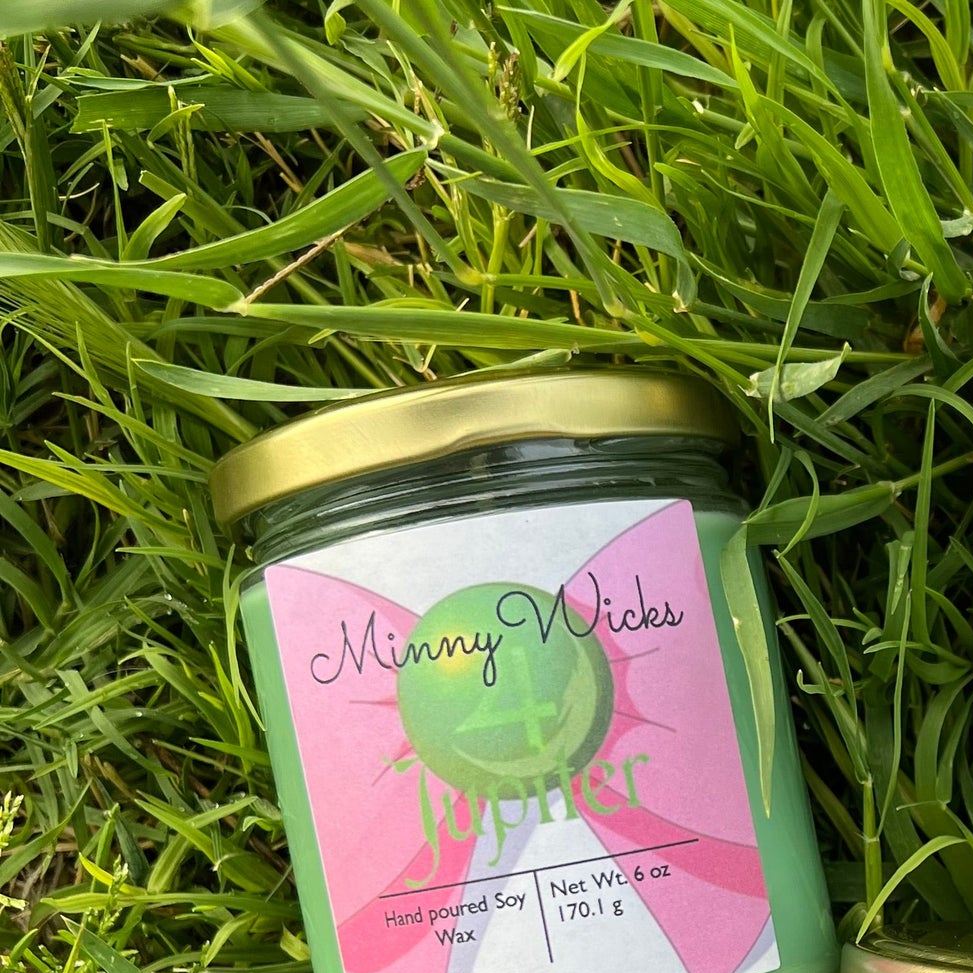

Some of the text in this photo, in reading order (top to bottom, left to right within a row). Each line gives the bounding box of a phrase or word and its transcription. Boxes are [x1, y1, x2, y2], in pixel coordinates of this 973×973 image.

[310, 572, 685, 688] Minny Wicks
[382, 751, 651, 889] Jupiter
[549, 864, 671, 899] Net Wt. 6 oz
[384, 891, 527, 930] Hand poured Soy
[557, 898, 625, 922] 170.1 g
[434, 925, 477, 947] Wax
